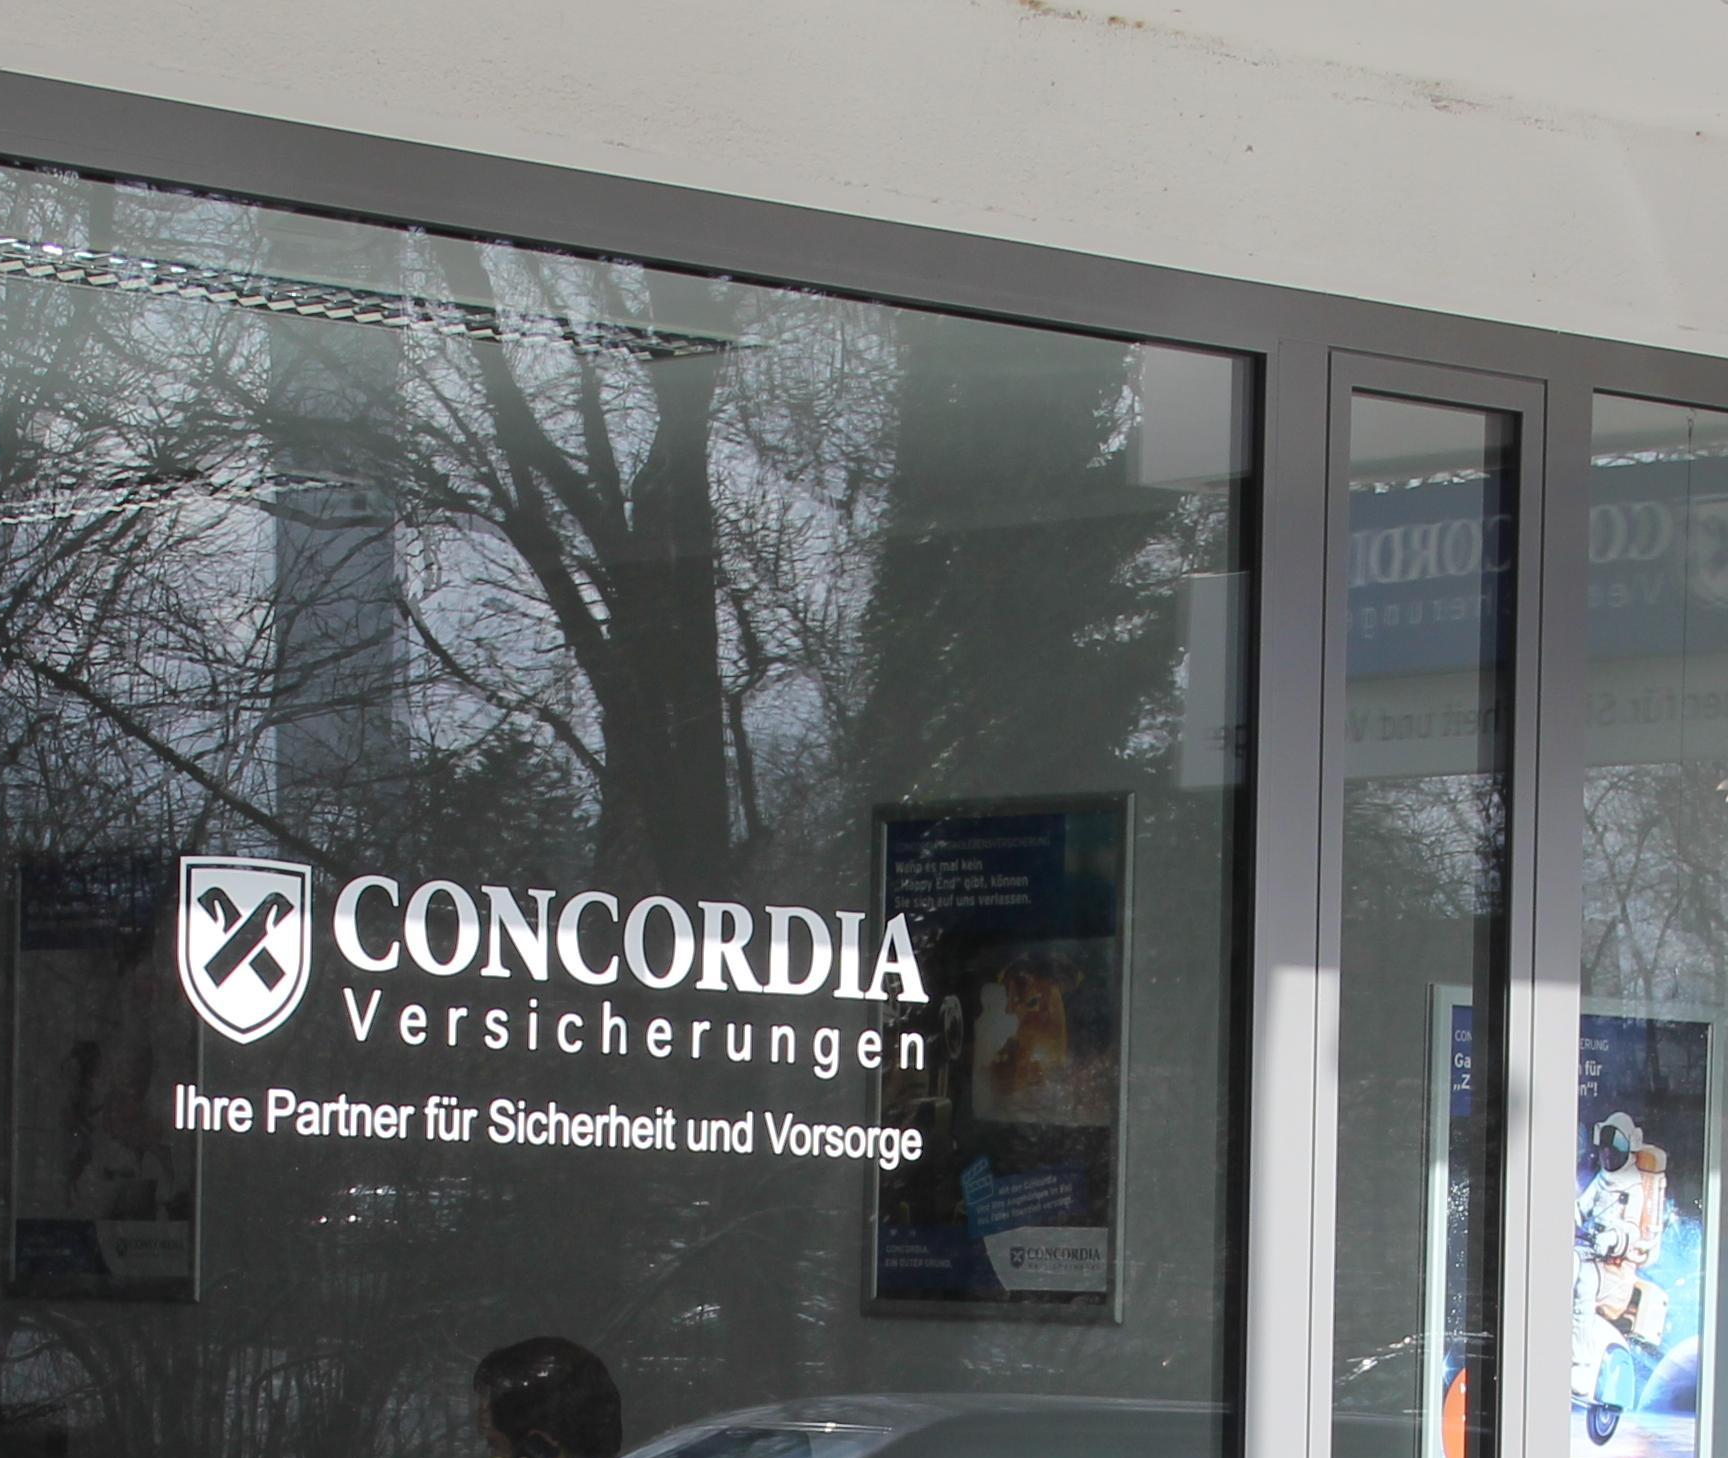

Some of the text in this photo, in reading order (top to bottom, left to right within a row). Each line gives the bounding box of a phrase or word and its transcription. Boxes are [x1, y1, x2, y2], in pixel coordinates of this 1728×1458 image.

[333, 874, 930, 1004] CONCORDIA
[343, 988, 927, 1080] Versicherungen
[174, 1084, 923, 1171] Ihre Partner für Sicherheit und Vorsorge
[1027, 1247, 1101, 1261] CONCORDIA
